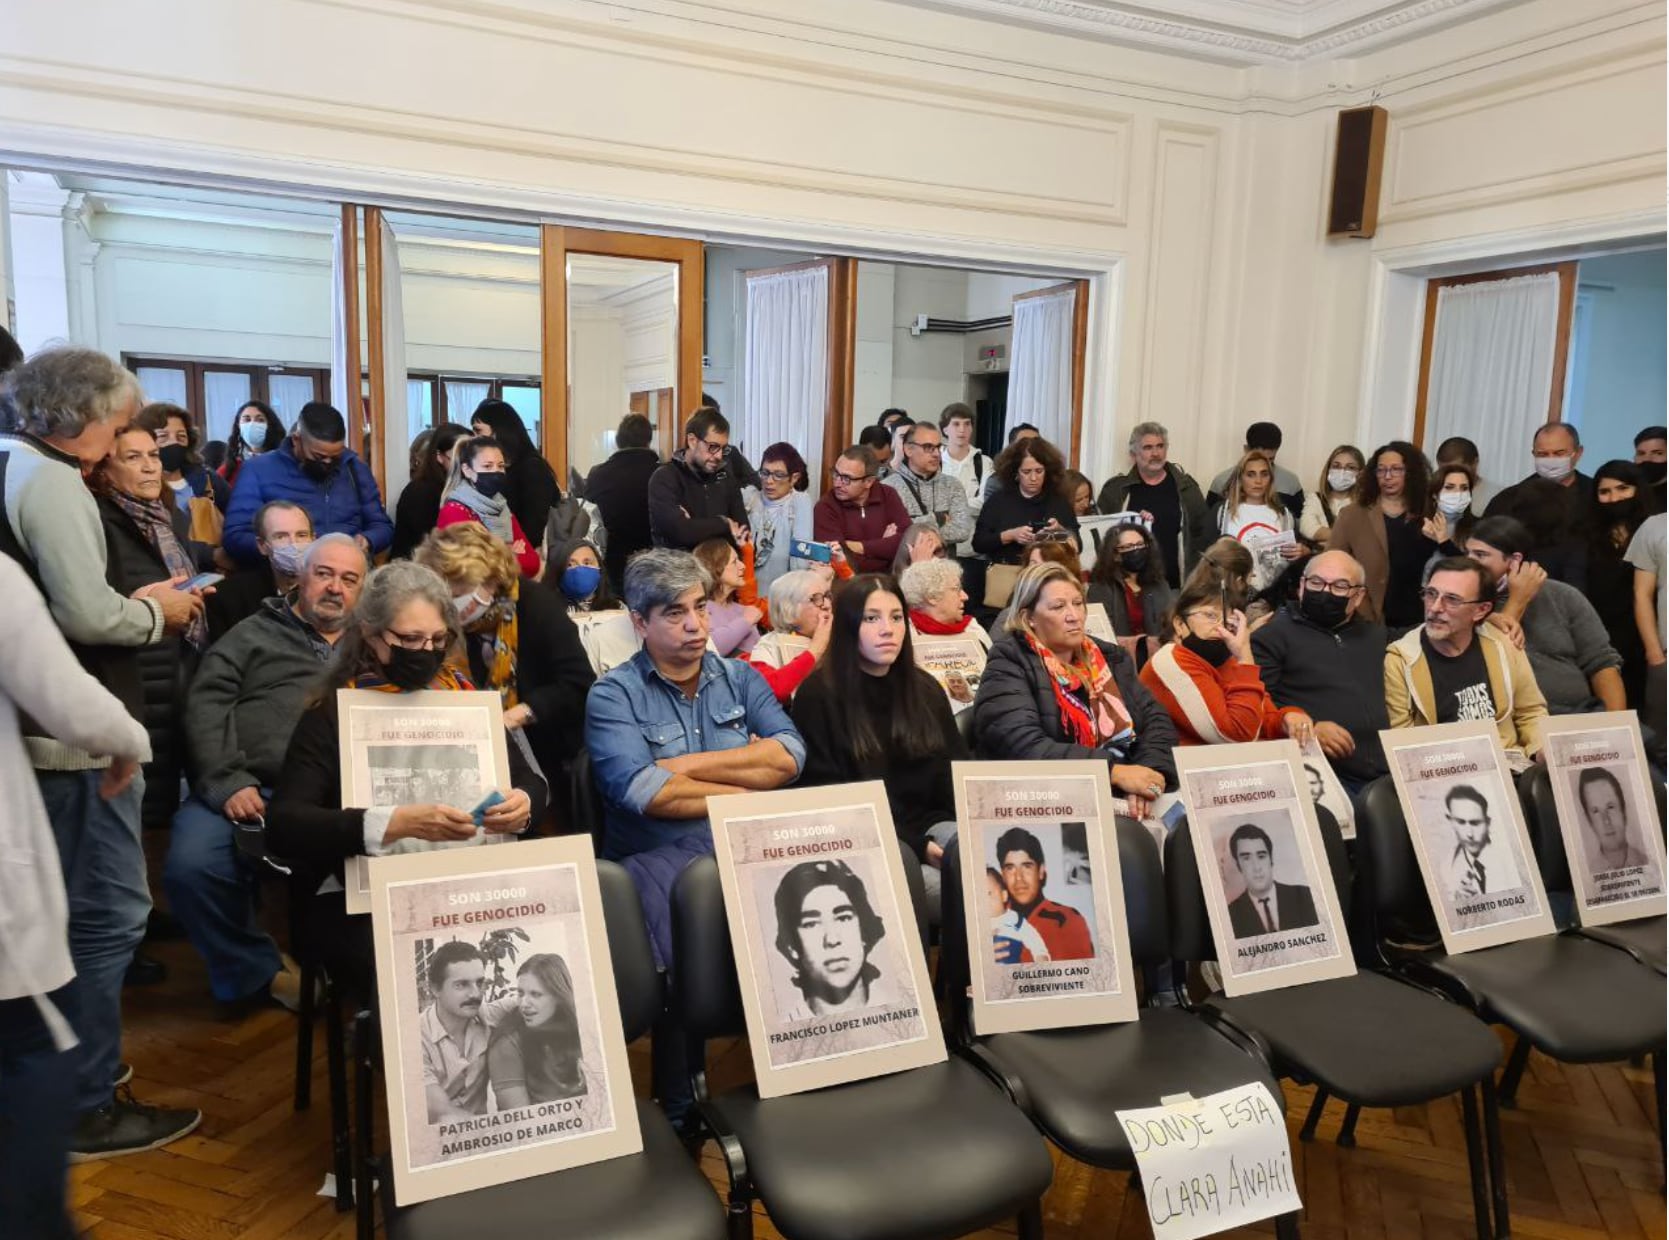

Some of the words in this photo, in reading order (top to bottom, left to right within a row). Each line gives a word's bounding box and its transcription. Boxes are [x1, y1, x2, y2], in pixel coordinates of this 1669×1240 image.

[1005, 791, 1028, 801] SON
[1029, 791, 1060, 800] 30000
[1213, 796, 1229, 805] FUE
[1229, 790, 1276, 803] GENOCIDIO
[995, 807, 1013, 817] FUE
[1016, 806, 1073, 816] GENOCIDIO
[772, 828, 799, 841] SON
[801, 824, 836, 837] 30000
[763, 848, 784, 859] FUE
[787, 839, 853, 856] GENOCIDIO
[448, 892, 481, 906] SON
[484, 887, 527, 902] 30000
[1456, 901, 1496, 916] NORBERTO
[1497, 894, 1525, 908] RODAS
[432, 913, 460, 927] FUE
[464, 903, 546, 923] GENOCIDIO
[1237, 940, 1286, 957] ALEJANDRO
[1287, 932, 1327, 948] SANCHEZ
[1012, 969, 1062, 980] GUILLERMO
[1064, 966, 1090, 976] CANO
[1018, 981, 1084, 994] SOBREVIVIENTE
[770, 1025, 827, 1044] FRANCISCO
[829, 1019, 860, 1033] LOPEZ
[862, 1007, 920, 1026] MUNTANER
[439, 1115, 501, 1137] PATRICIA
[503, 1108, 535, 1124] DELL
[537, 1101, 572, 1118] ORTO
[575, 1099, 583, 1110] Y
[441, 1131, 513, 1156] AMBROSIO
[516, 1128, 533, 1140] DE
[536, 1117, 583, 1136] MARCO
[1125, 1113, 1213, 1154] DONDE
[1150, 1173, 1221, 1225] CLARA
